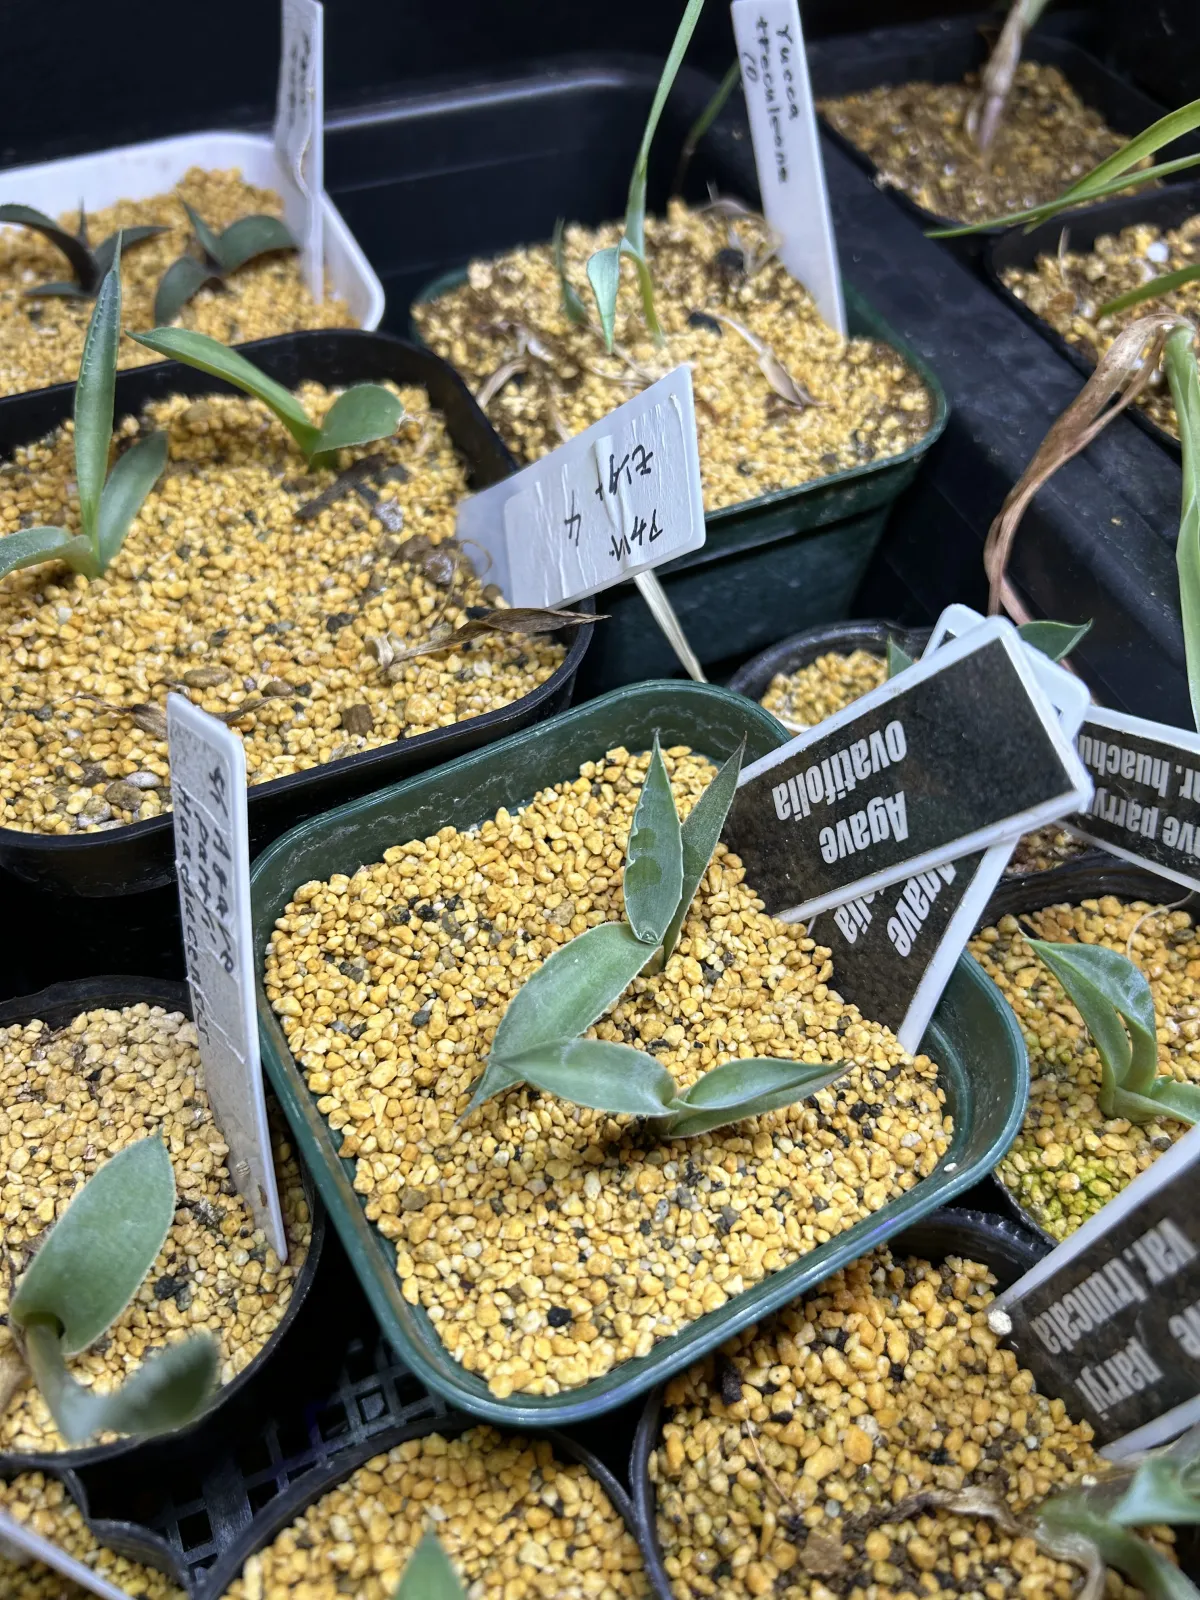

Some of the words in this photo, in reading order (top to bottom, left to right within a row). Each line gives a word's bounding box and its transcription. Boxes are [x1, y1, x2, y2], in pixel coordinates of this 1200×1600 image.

[776, 24, 800, 120] Yucca
[563, 490, 582, 546] 4
[771, 720, 908, 822] ovatifolia
[1075, 734, 1170, 798] huachu
[819, 791, 909, 865] Agave
[211, 828, 237, 973] Agave
[1122, 1216, 1198, 1288] var.
[1029, 1256, 1149, 1356] truncata
[1074, 1336, 1164, 1420] parryi
